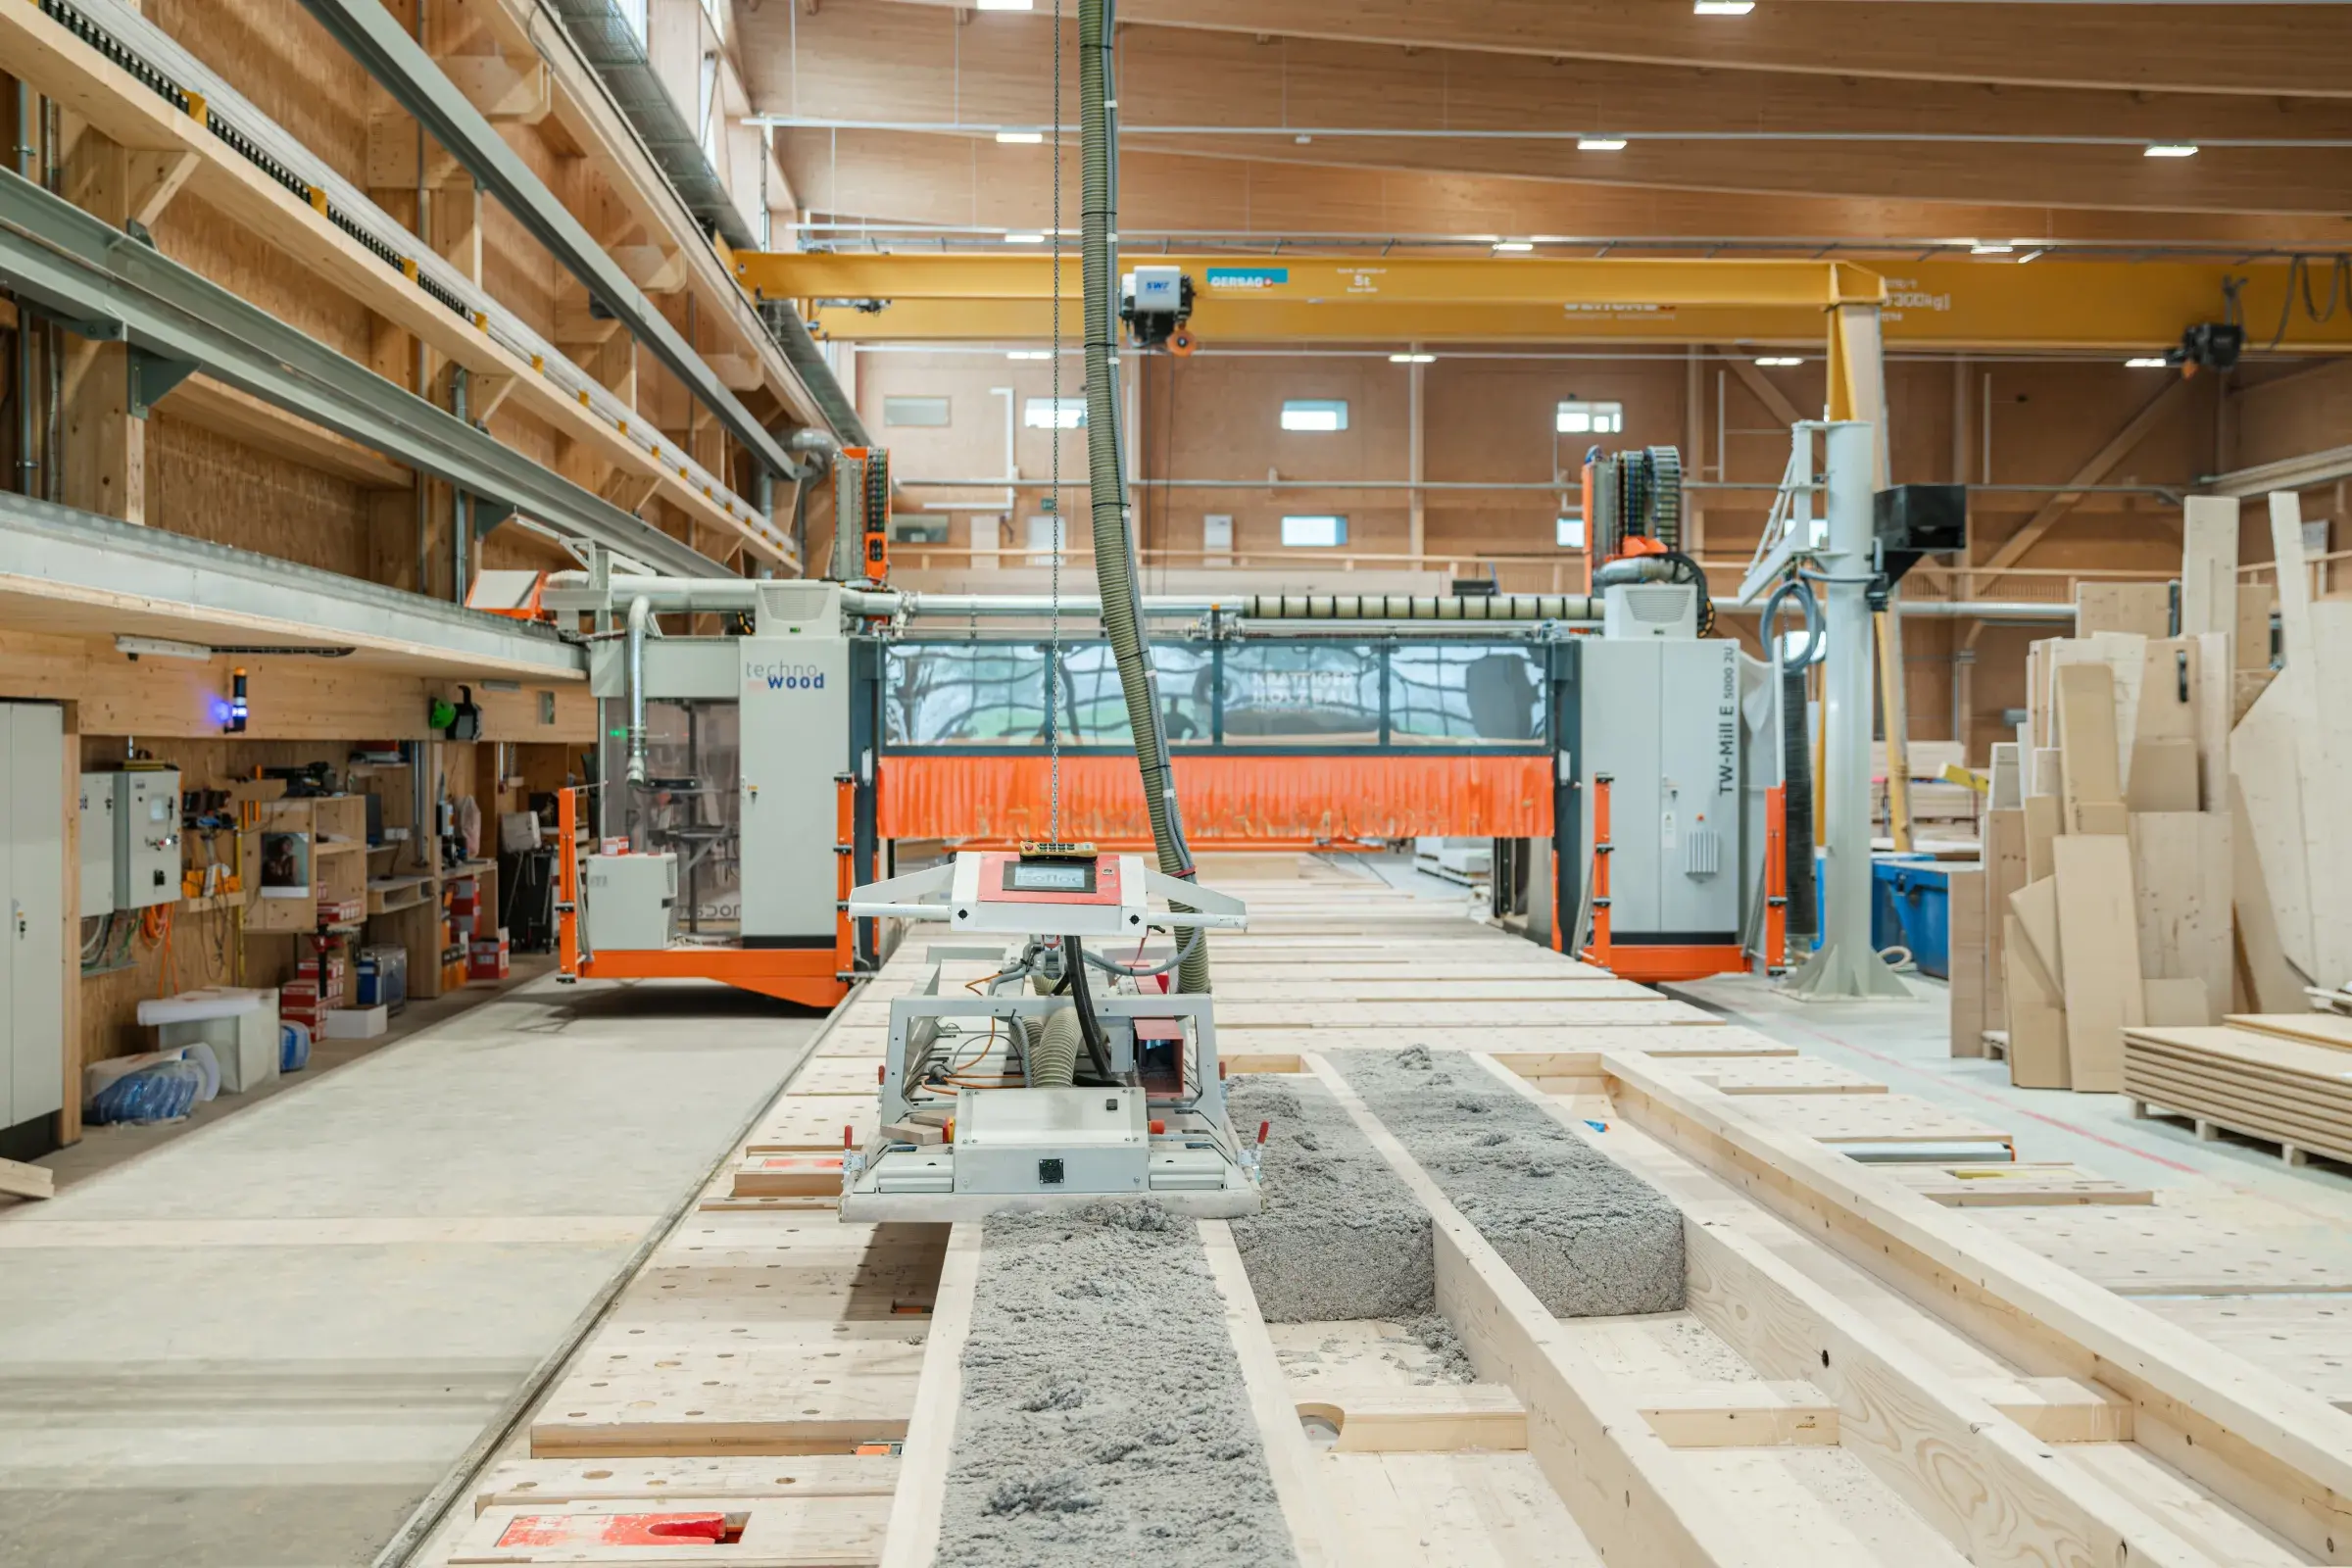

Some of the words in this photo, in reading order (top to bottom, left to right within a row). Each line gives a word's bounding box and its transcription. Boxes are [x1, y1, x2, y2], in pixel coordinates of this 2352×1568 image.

[746, 659, 818, 678] techno
[767, 671, 825, 690] wood
[1723, 667, 1735, 700] 5000
[1718, 706, 1734, 715] E
[1718, 722, 1734, 797] TW-Mill
